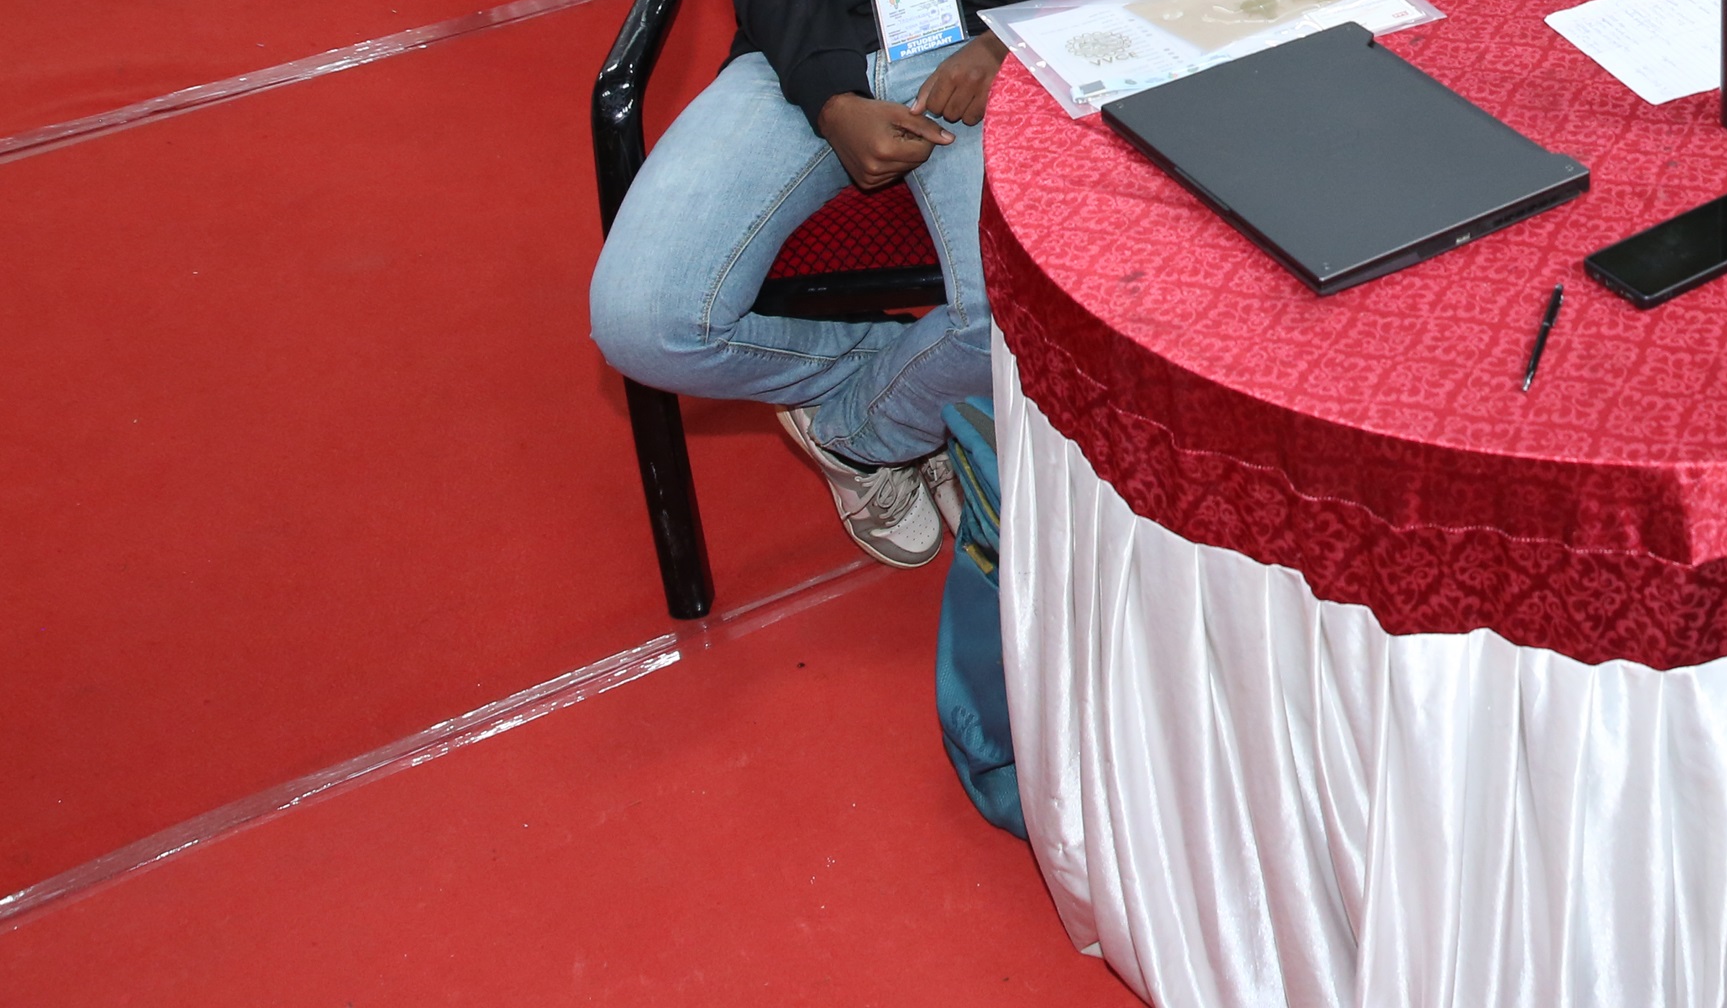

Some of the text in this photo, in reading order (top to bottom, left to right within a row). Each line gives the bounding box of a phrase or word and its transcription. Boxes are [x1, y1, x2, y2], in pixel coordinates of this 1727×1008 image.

[900, 36, 954, 58] PARTICIPANT
[906, 32, 944, 49] STUDENT
[1089, 52, 1138, 67] VVCE
